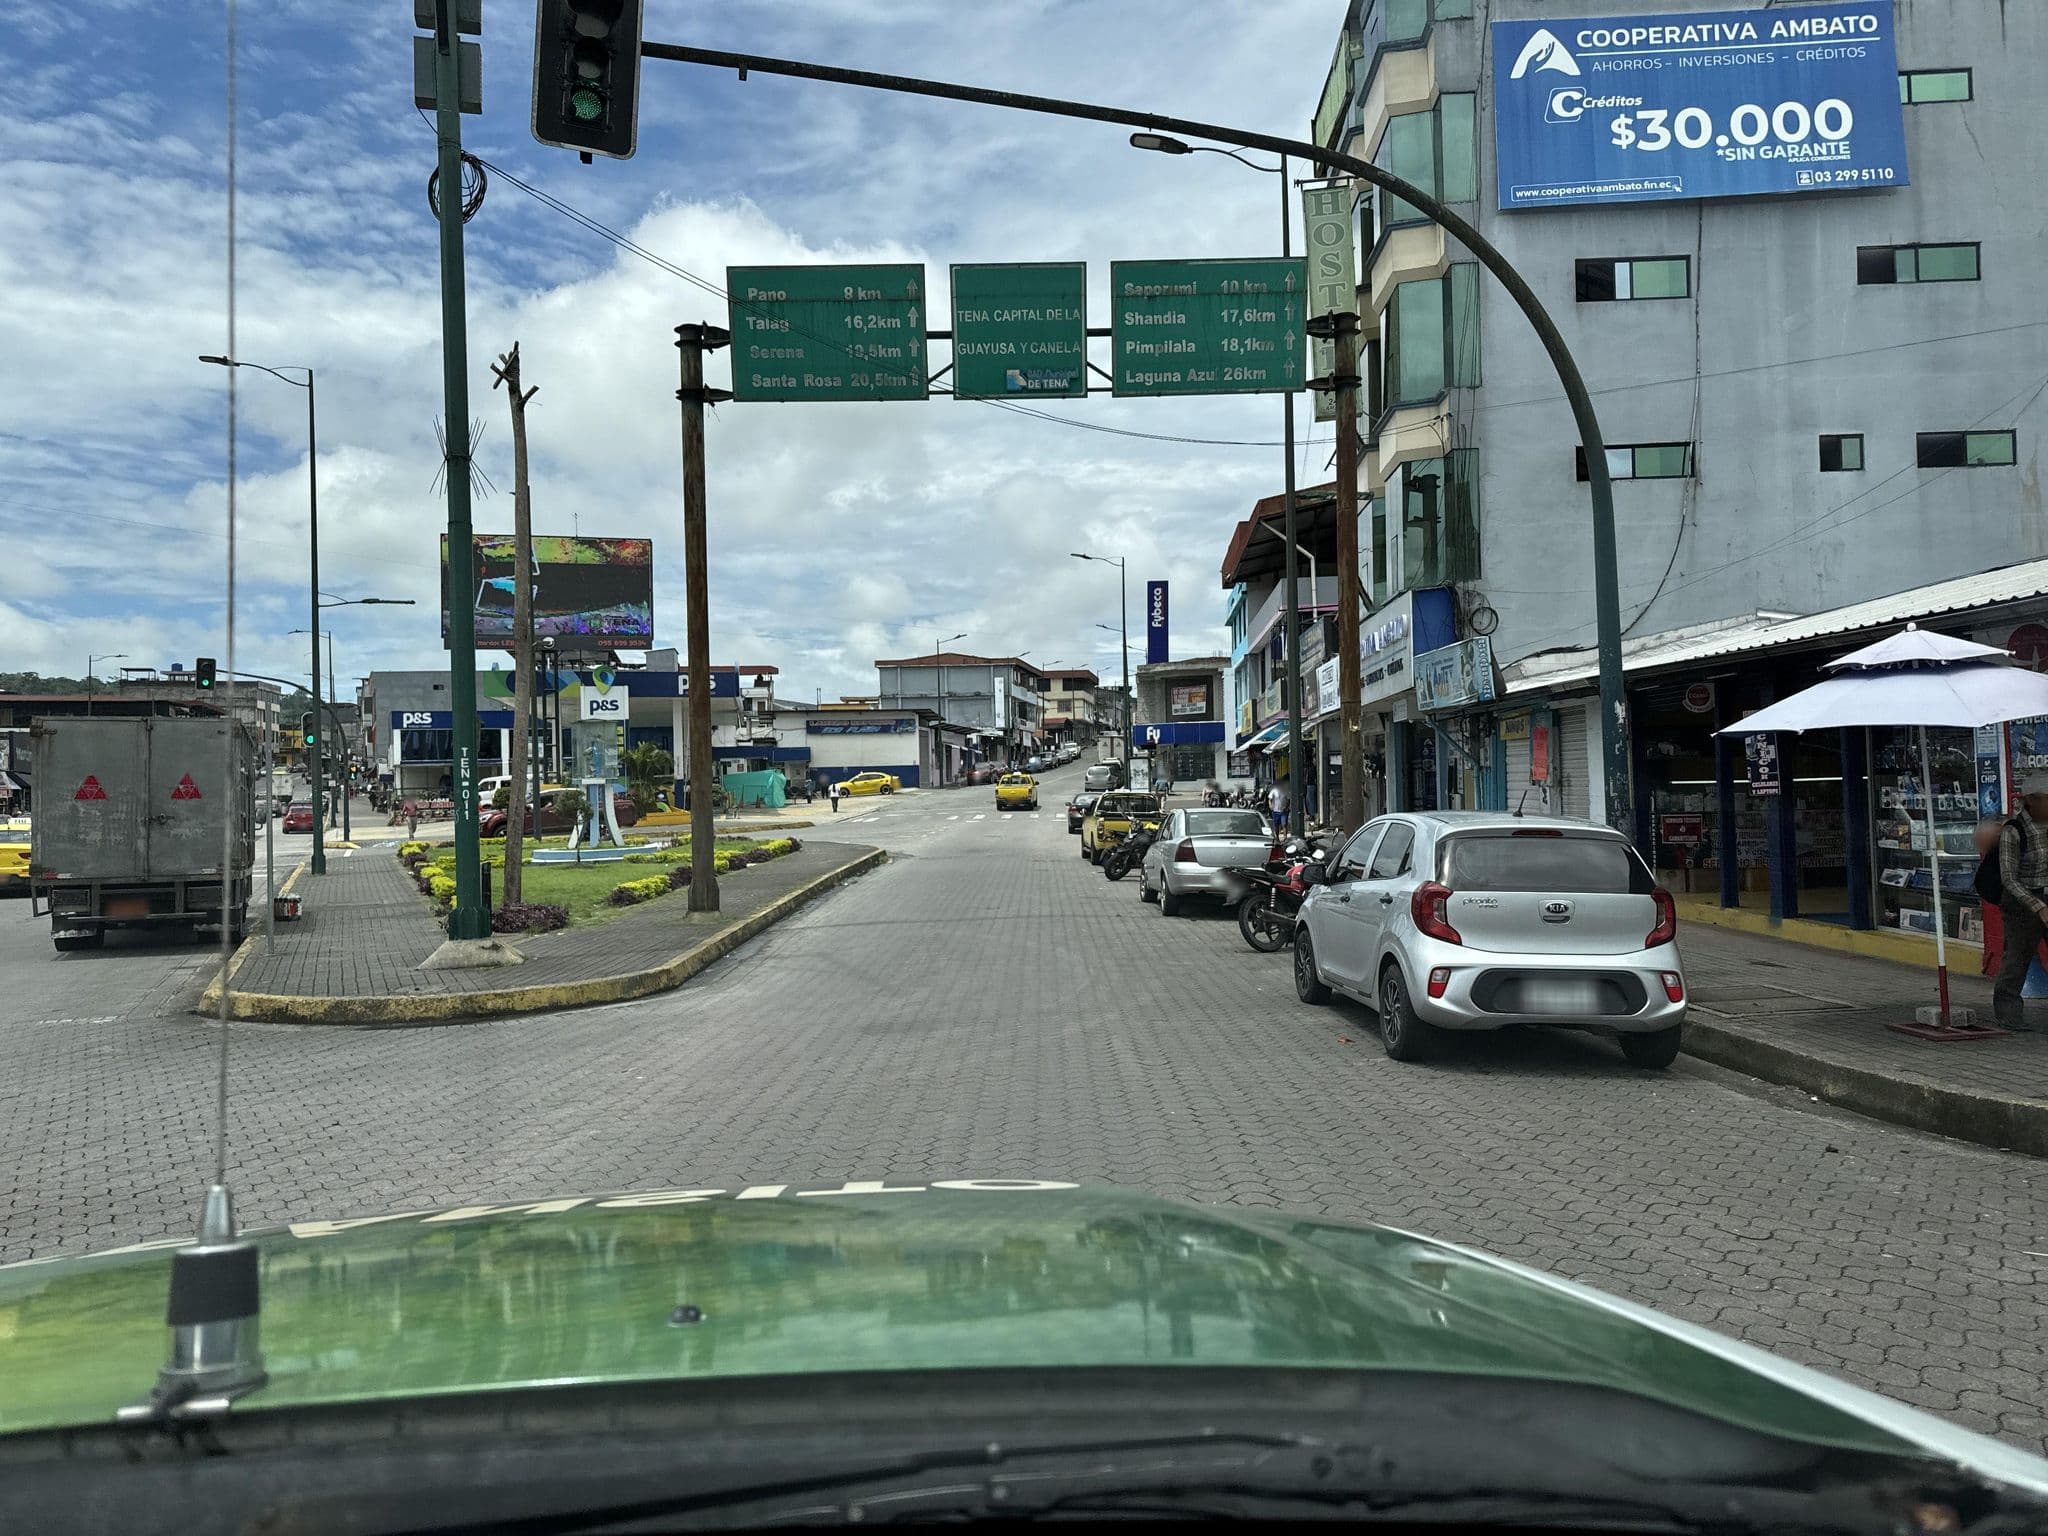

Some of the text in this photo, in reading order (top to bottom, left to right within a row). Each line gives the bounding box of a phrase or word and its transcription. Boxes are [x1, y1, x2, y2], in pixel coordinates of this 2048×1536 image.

[1575, 14, 1878, 48] COOPERATIVA AMBATO
[1592, 45, 1866, 72] AHORROS INVERSIONES CRÉDITOS
[1582, 96, 1643, 108] Créditos
[1610, 98, 1853, 151] $30.000
[1760, 140, 1851, 159] GARANTE
[1815, 167, 1894, 183] 03 299 5110
[747, 286, 881, 301] Pano 8 km
[957, 308, 1081, 322] TENA CAPITAL DE LA
[1124, 309, 1276, 326] Shandia 17,6km
[746, 315, 901, 333] Talag 16,2km
[750, 345, 804, 359] Serena
[958, 341, 1081, 355] GUAYUSA Y CANELA
[1126, 338, 1275, 357] Pimpilala 18,1km
[752, 374, 797, 388] Santa
[804, 374, 842, 388] Rosa
[1027, 379, 1069, 389] DE TENA
[1126, 370, 1181, 386] Laguna
[1223, 367, 1267, 381] 26km
[1152, 587, 1163, 628] Fybeca
[589, 699, 619, 716] p&s
[403, 712, 432, 729] p&s
[1146, 726, 1161, 744] Fy
[460, 747, 470, 820] TEN-011
[1980, 774, 1997, 784] CHIP
[1463, 897, 1498, 906] picanto
[1549, 904, 1568, 912] KIA
